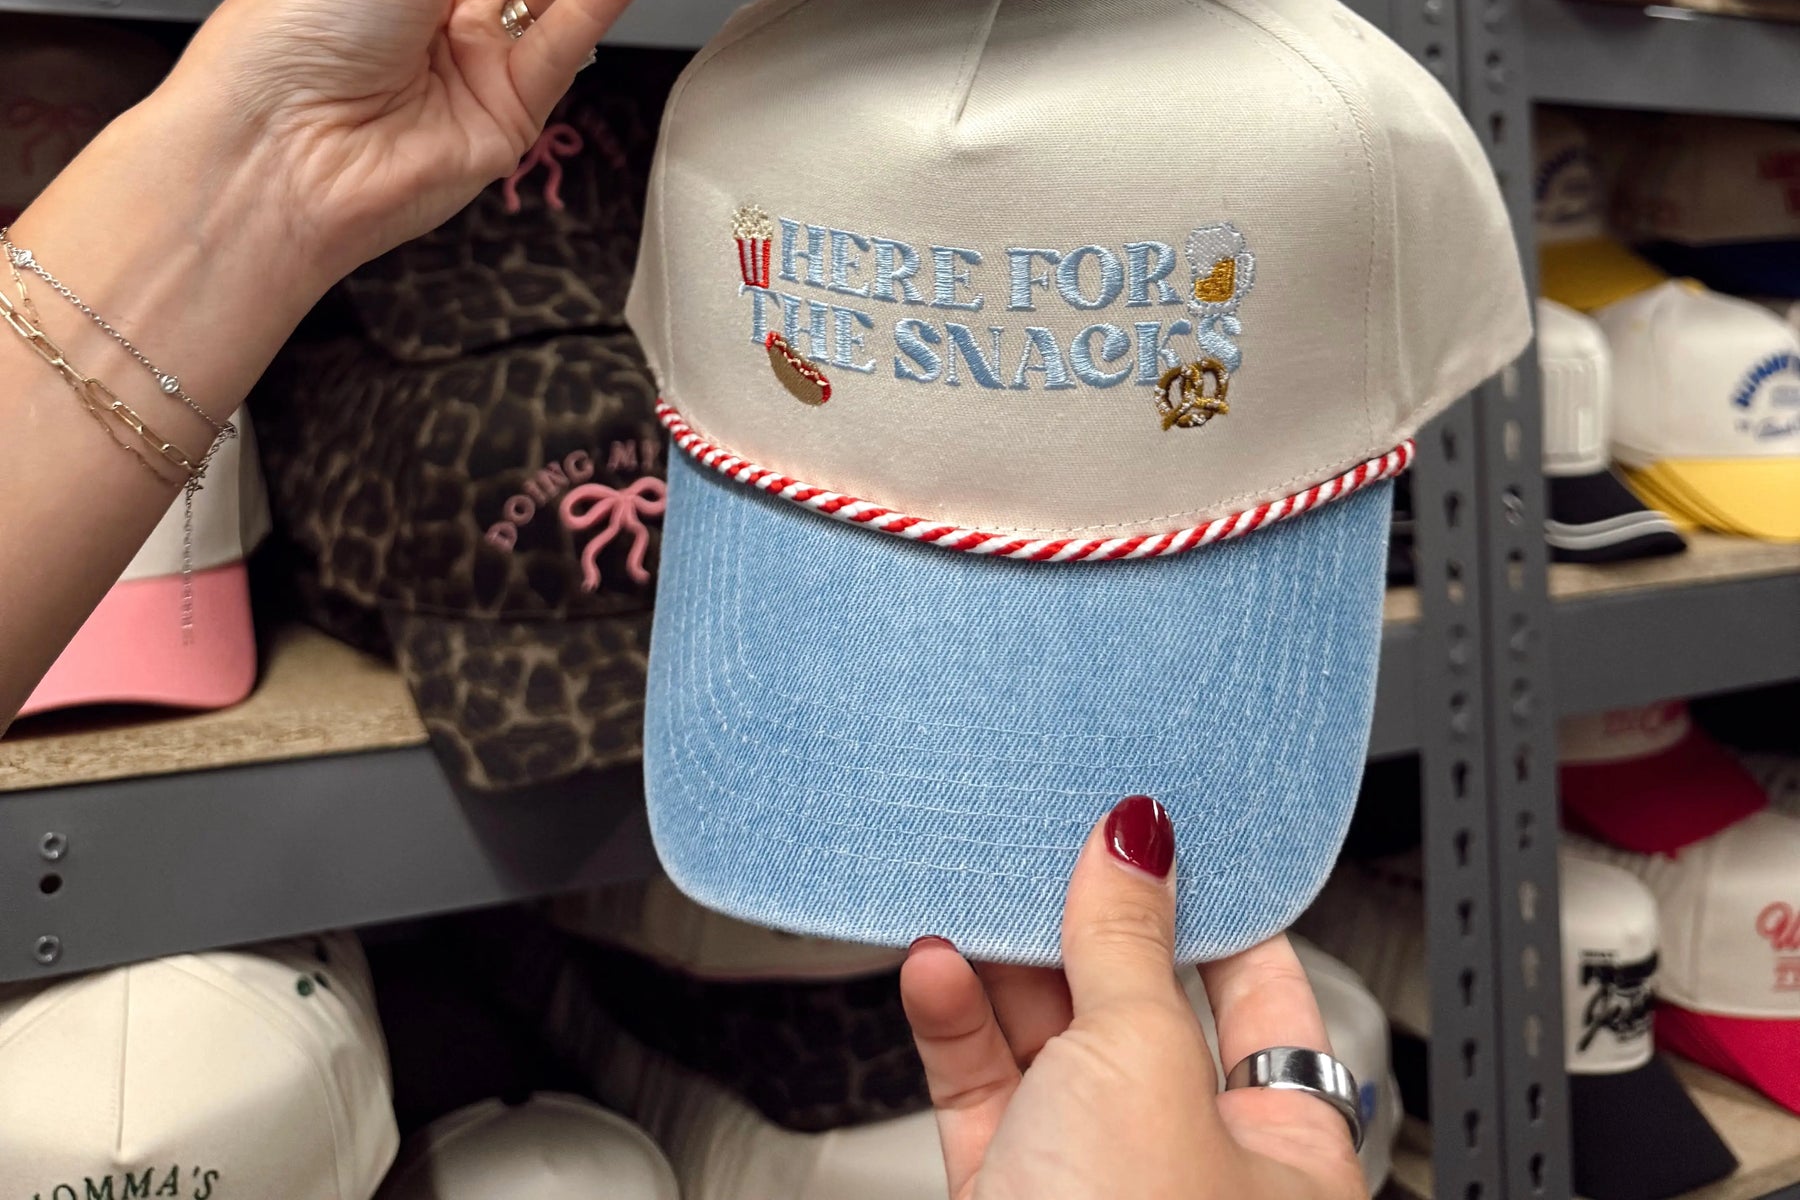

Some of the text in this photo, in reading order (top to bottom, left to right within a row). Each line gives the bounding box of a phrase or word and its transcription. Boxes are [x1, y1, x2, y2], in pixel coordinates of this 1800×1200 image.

[778, 216, 1184, 311] HERE FOR
[737, 282, 1243, 391] THE SNACKS
[484, 449, 595, 552] DOING
[30, 1163, 220, 1200] OMMA'S
